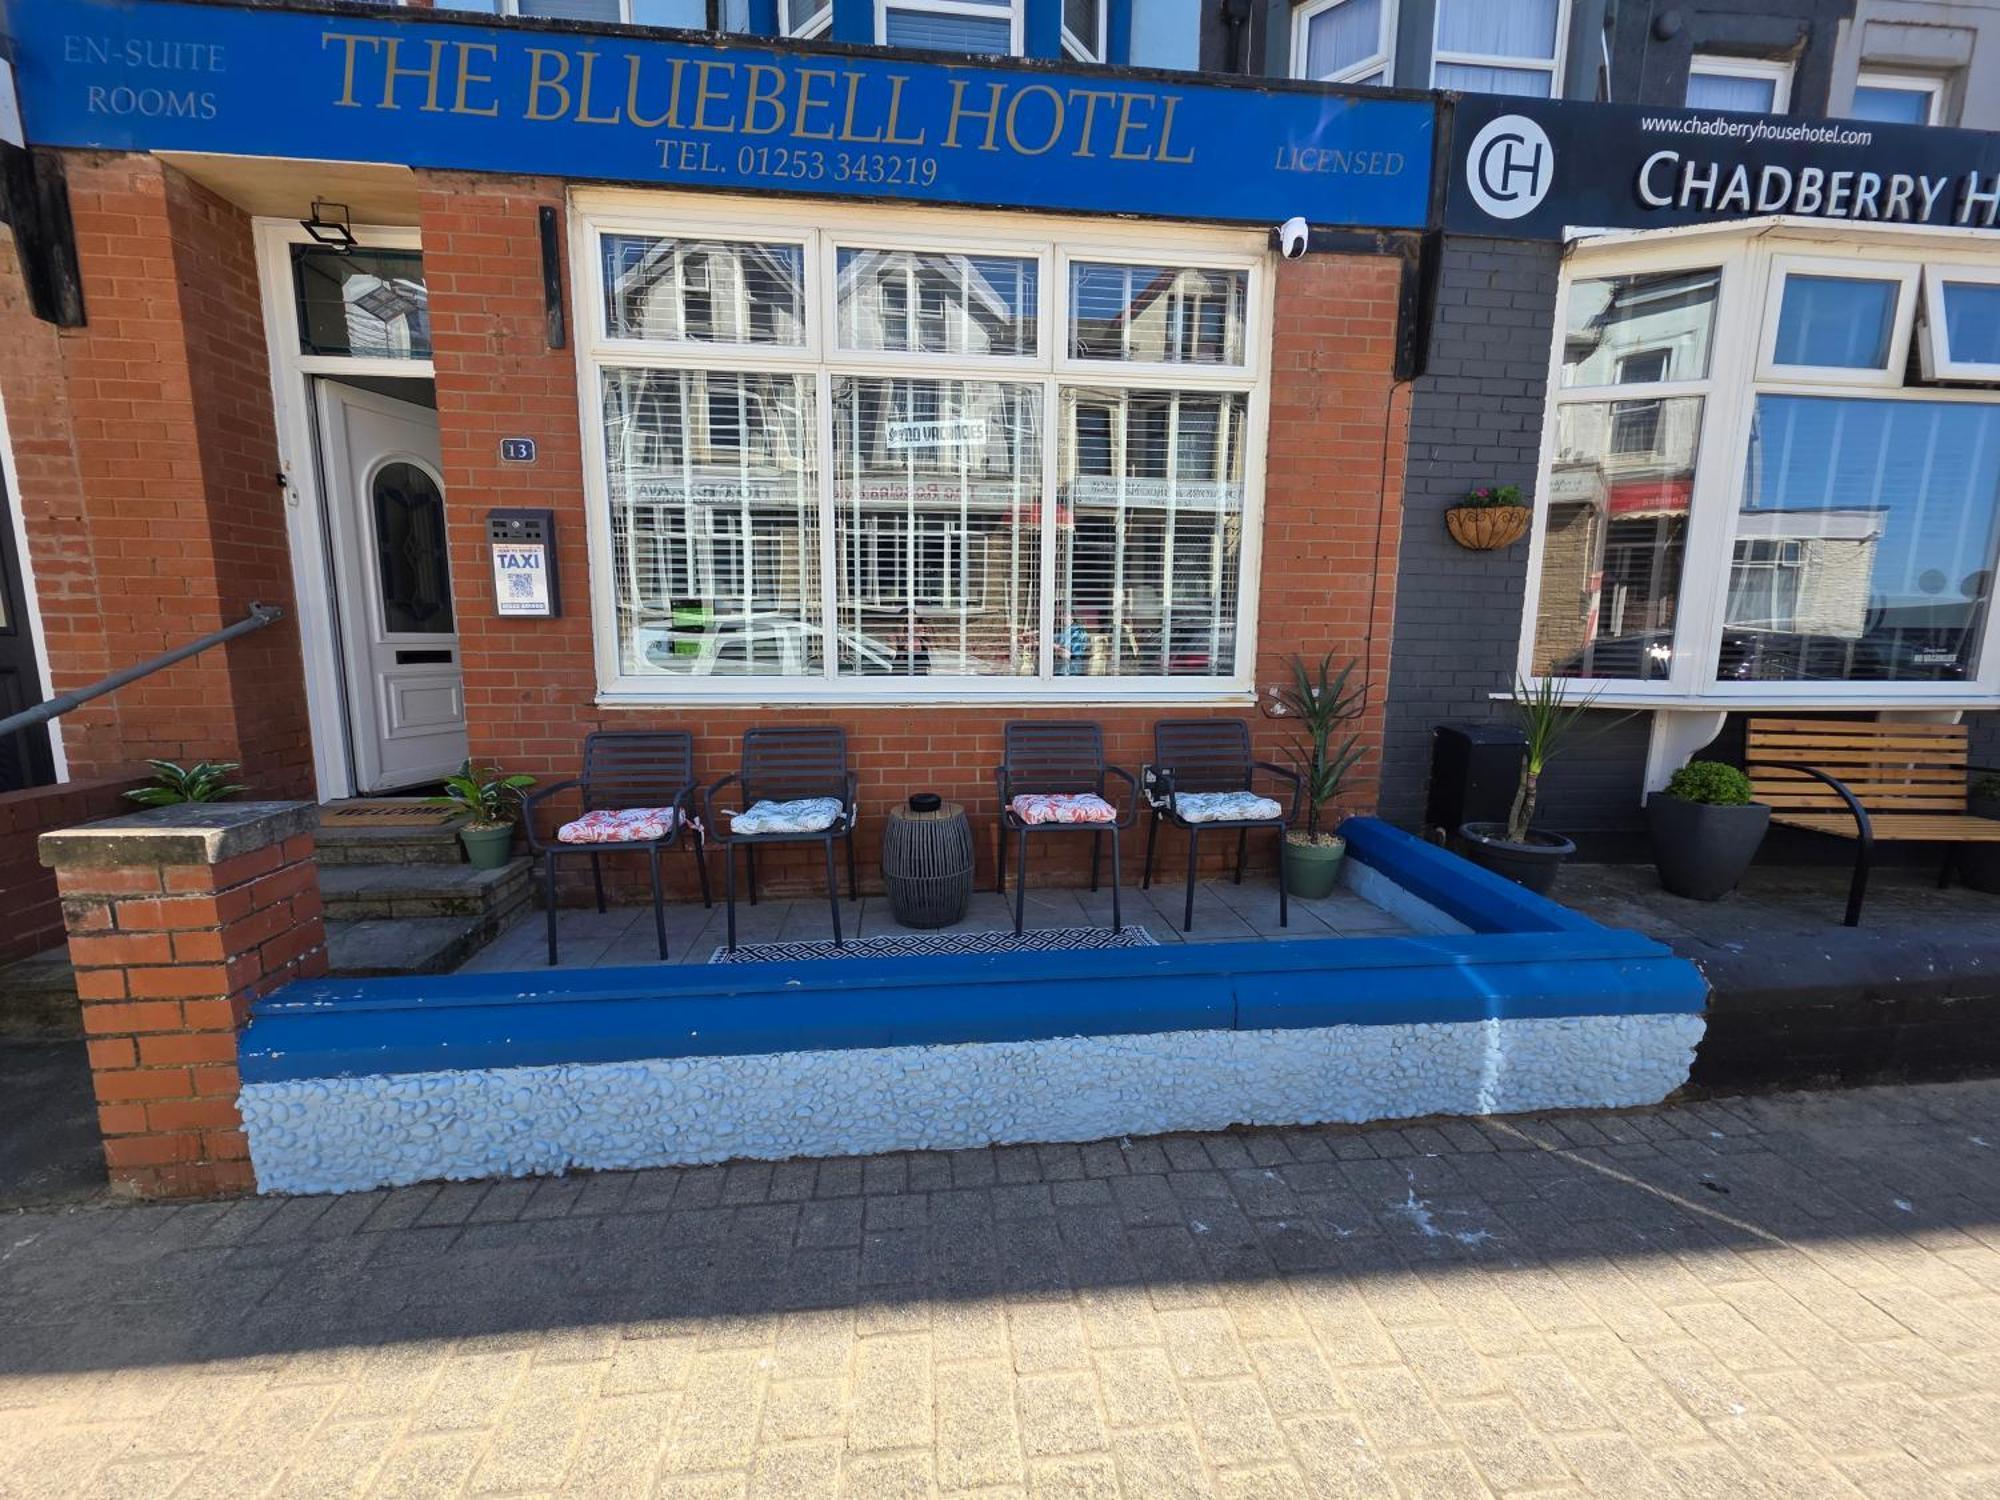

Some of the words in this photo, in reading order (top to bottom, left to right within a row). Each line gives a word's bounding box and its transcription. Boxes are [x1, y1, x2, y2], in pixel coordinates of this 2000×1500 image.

[64, 34, 226, 73] EN-SUITE
[87, 85, 217, 120] ROOMS
[322, 32, 499, 117] THE
[523, 48, 925, 145] BLUEBELL
[940, 79, 1195, 165] HOTEL
[1642, 115, 1872, 146] www.chadberryhousehotel.com
[656, 139, 726, 173] TEL.
[738, 146, 824, 180] 01253
[834, 152, 937, 187] 343219
[1275, 146, 1405, 176] LICENSED
[1638, 149, 1948, 221] CHADBERRY
[508, 444, 527, 458] 13
[497, 554, 540, 569] TAXI
[335, 806, 449, 816] WELCOME
